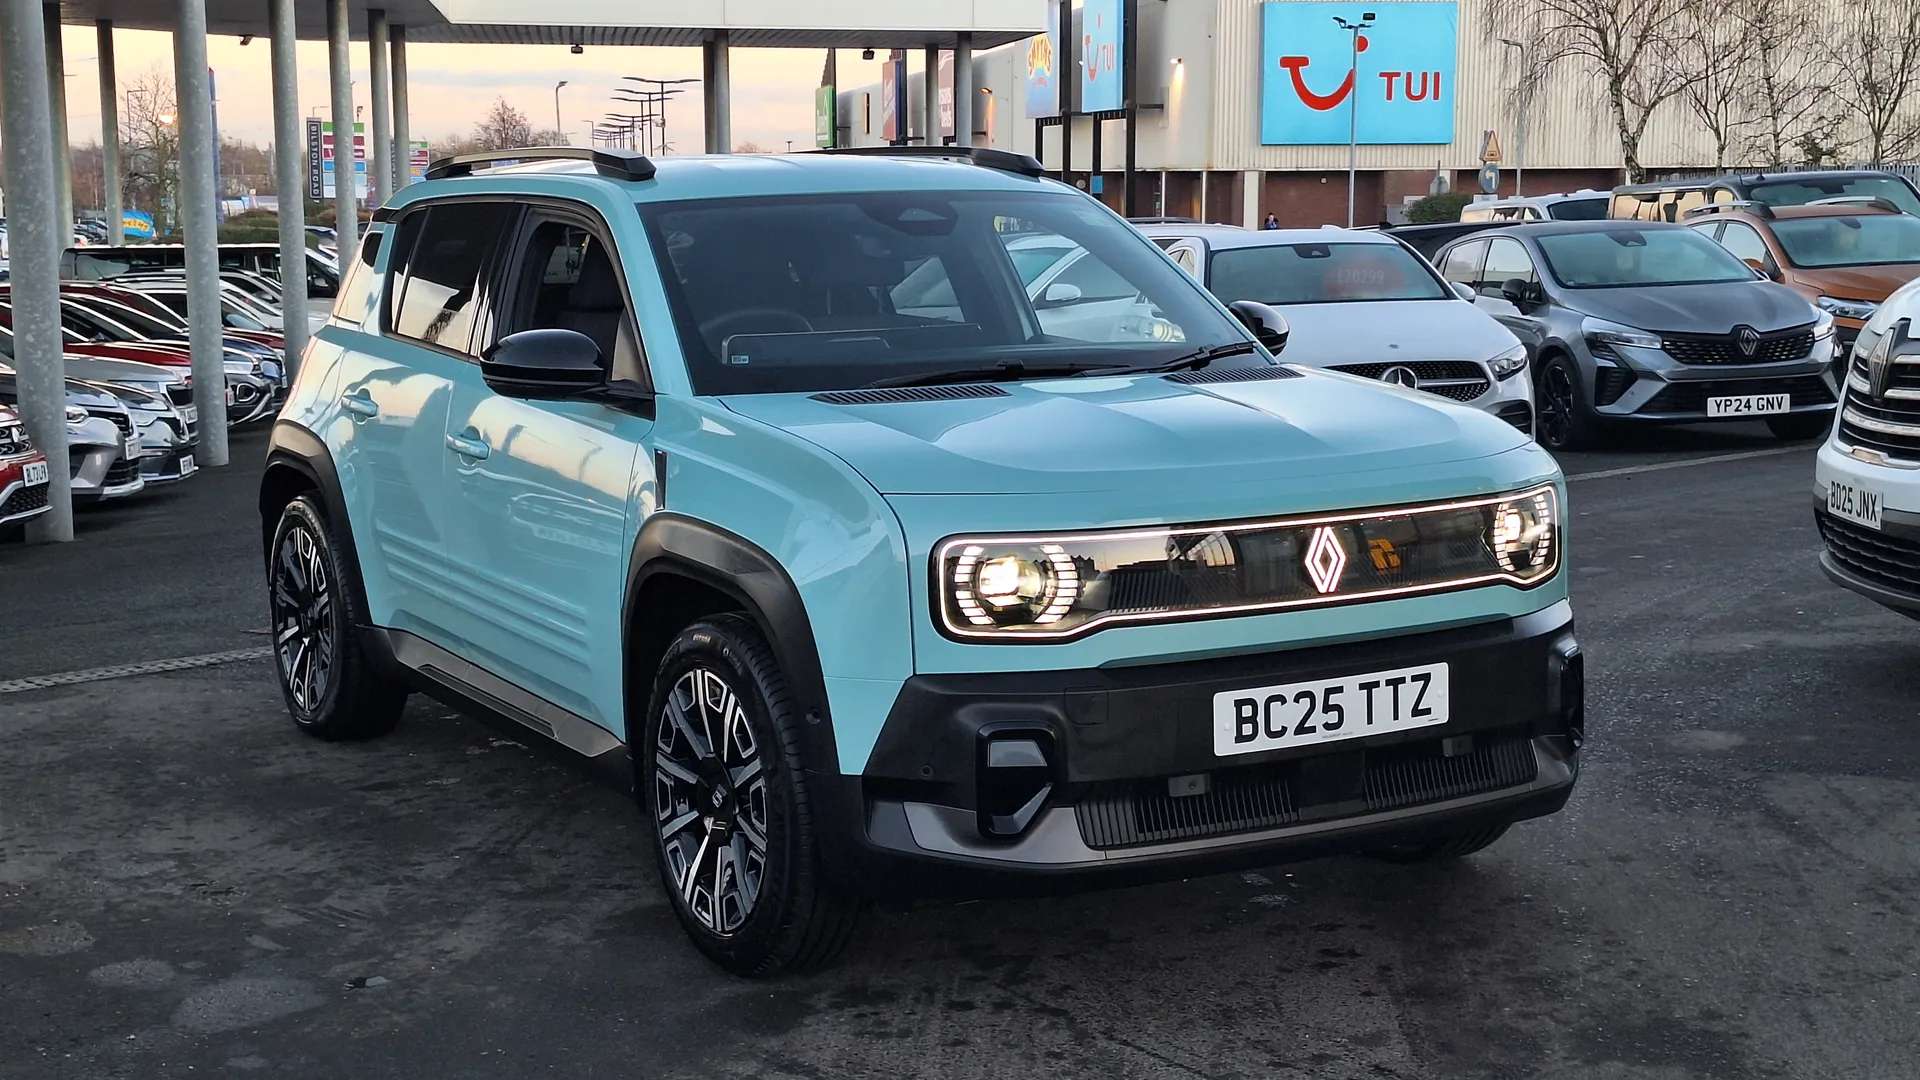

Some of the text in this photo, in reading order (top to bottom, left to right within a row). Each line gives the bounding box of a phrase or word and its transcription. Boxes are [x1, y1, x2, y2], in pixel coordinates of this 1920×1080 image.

[1102, 43, 1114, 71] TUI
[1378, 71, 1440, 101] TUI
[310, 125, 320, 195] BILSTON ROAD
[1714, 396, 1784, 413] YP24 GNV
[1830, 480, 1877, 522] BD25 JNX
[1233, 672, 1432, 744] BC25 TTZ
